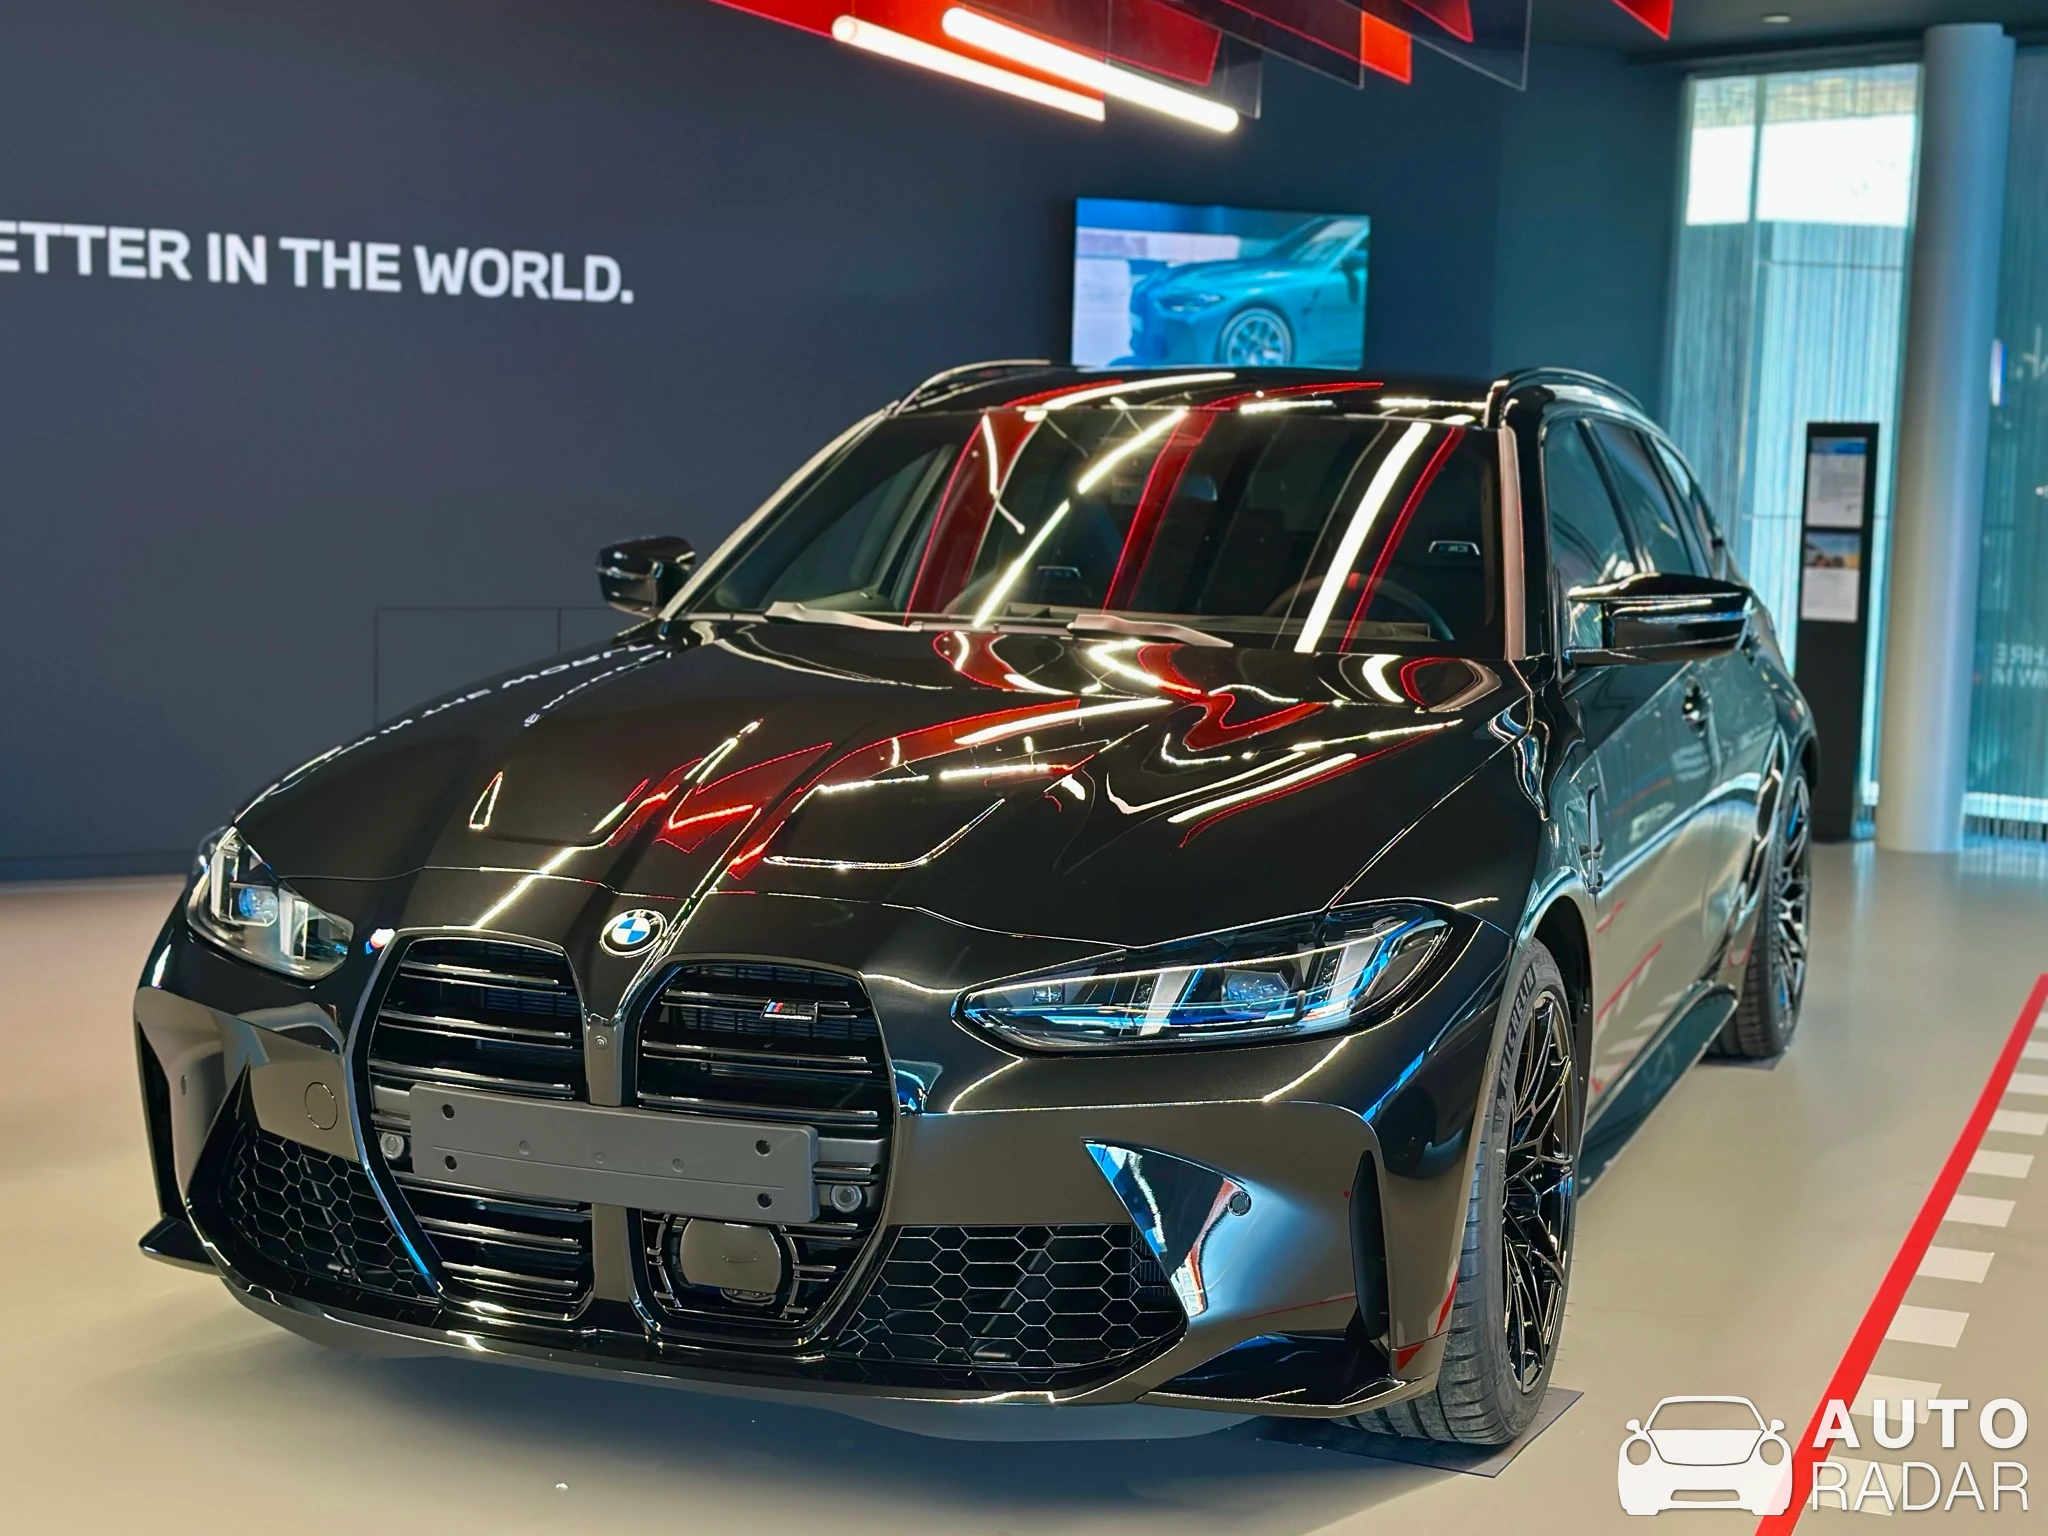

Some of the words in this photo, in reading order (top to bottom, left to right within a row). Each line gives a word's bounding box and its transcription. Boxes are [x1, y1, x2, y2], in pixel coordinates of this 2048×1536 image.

[207, 232, 268, 285] IN
[279, 236, 402, 293] THE
[413, 245, 635, 304] WORLD.
[1499, 966, 1537, 1089] MICHELIN
